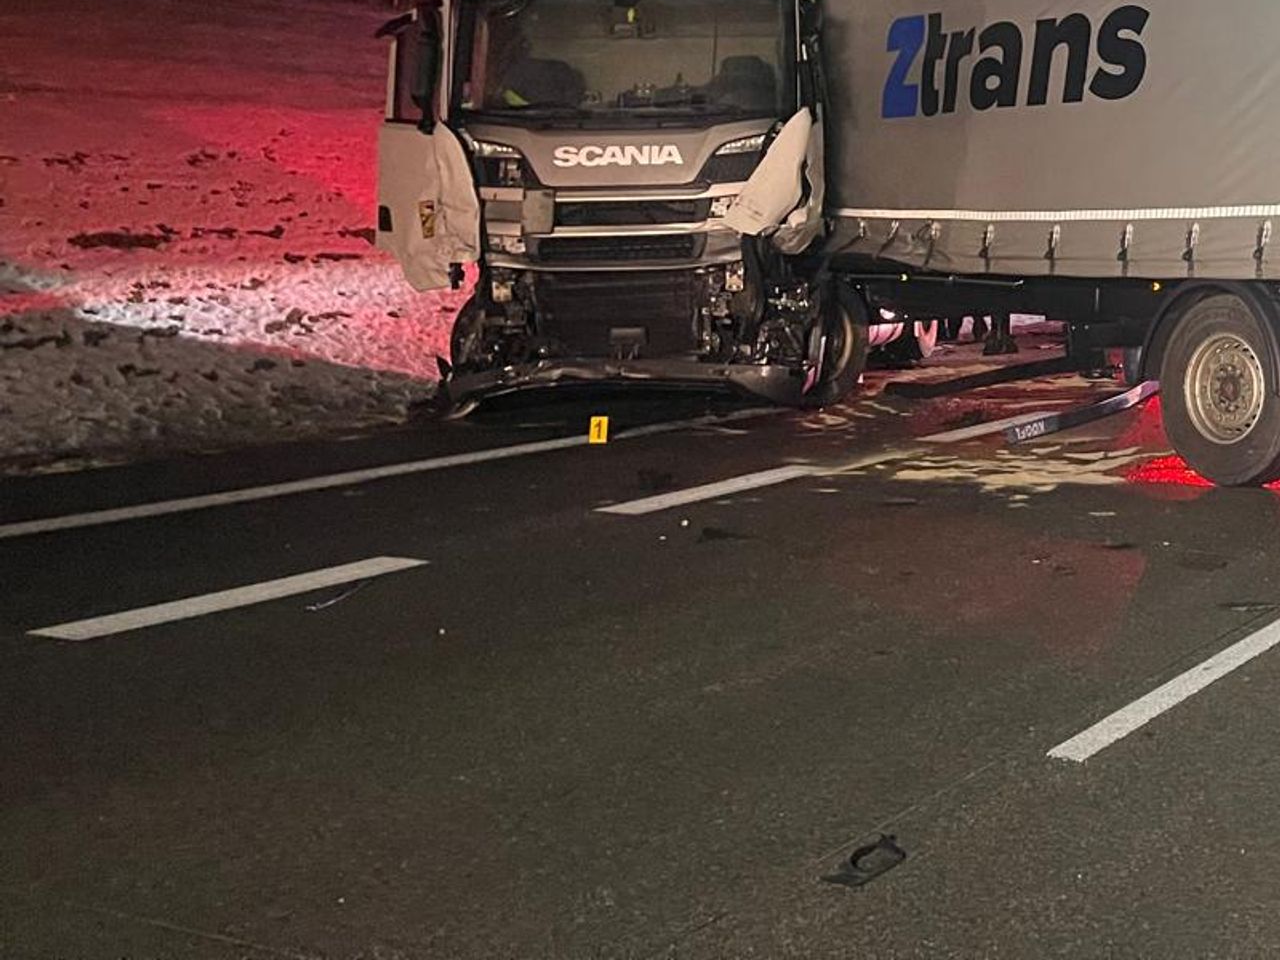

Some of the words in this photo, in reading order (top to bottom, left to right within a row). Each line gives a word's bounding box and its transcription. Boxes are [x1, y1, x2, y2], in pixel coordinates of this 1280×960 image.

[881, 5, 1150, 118] Ztrans
[553, 145, 683, 167] SCANIA
[593, 419, 602, 440] 1
